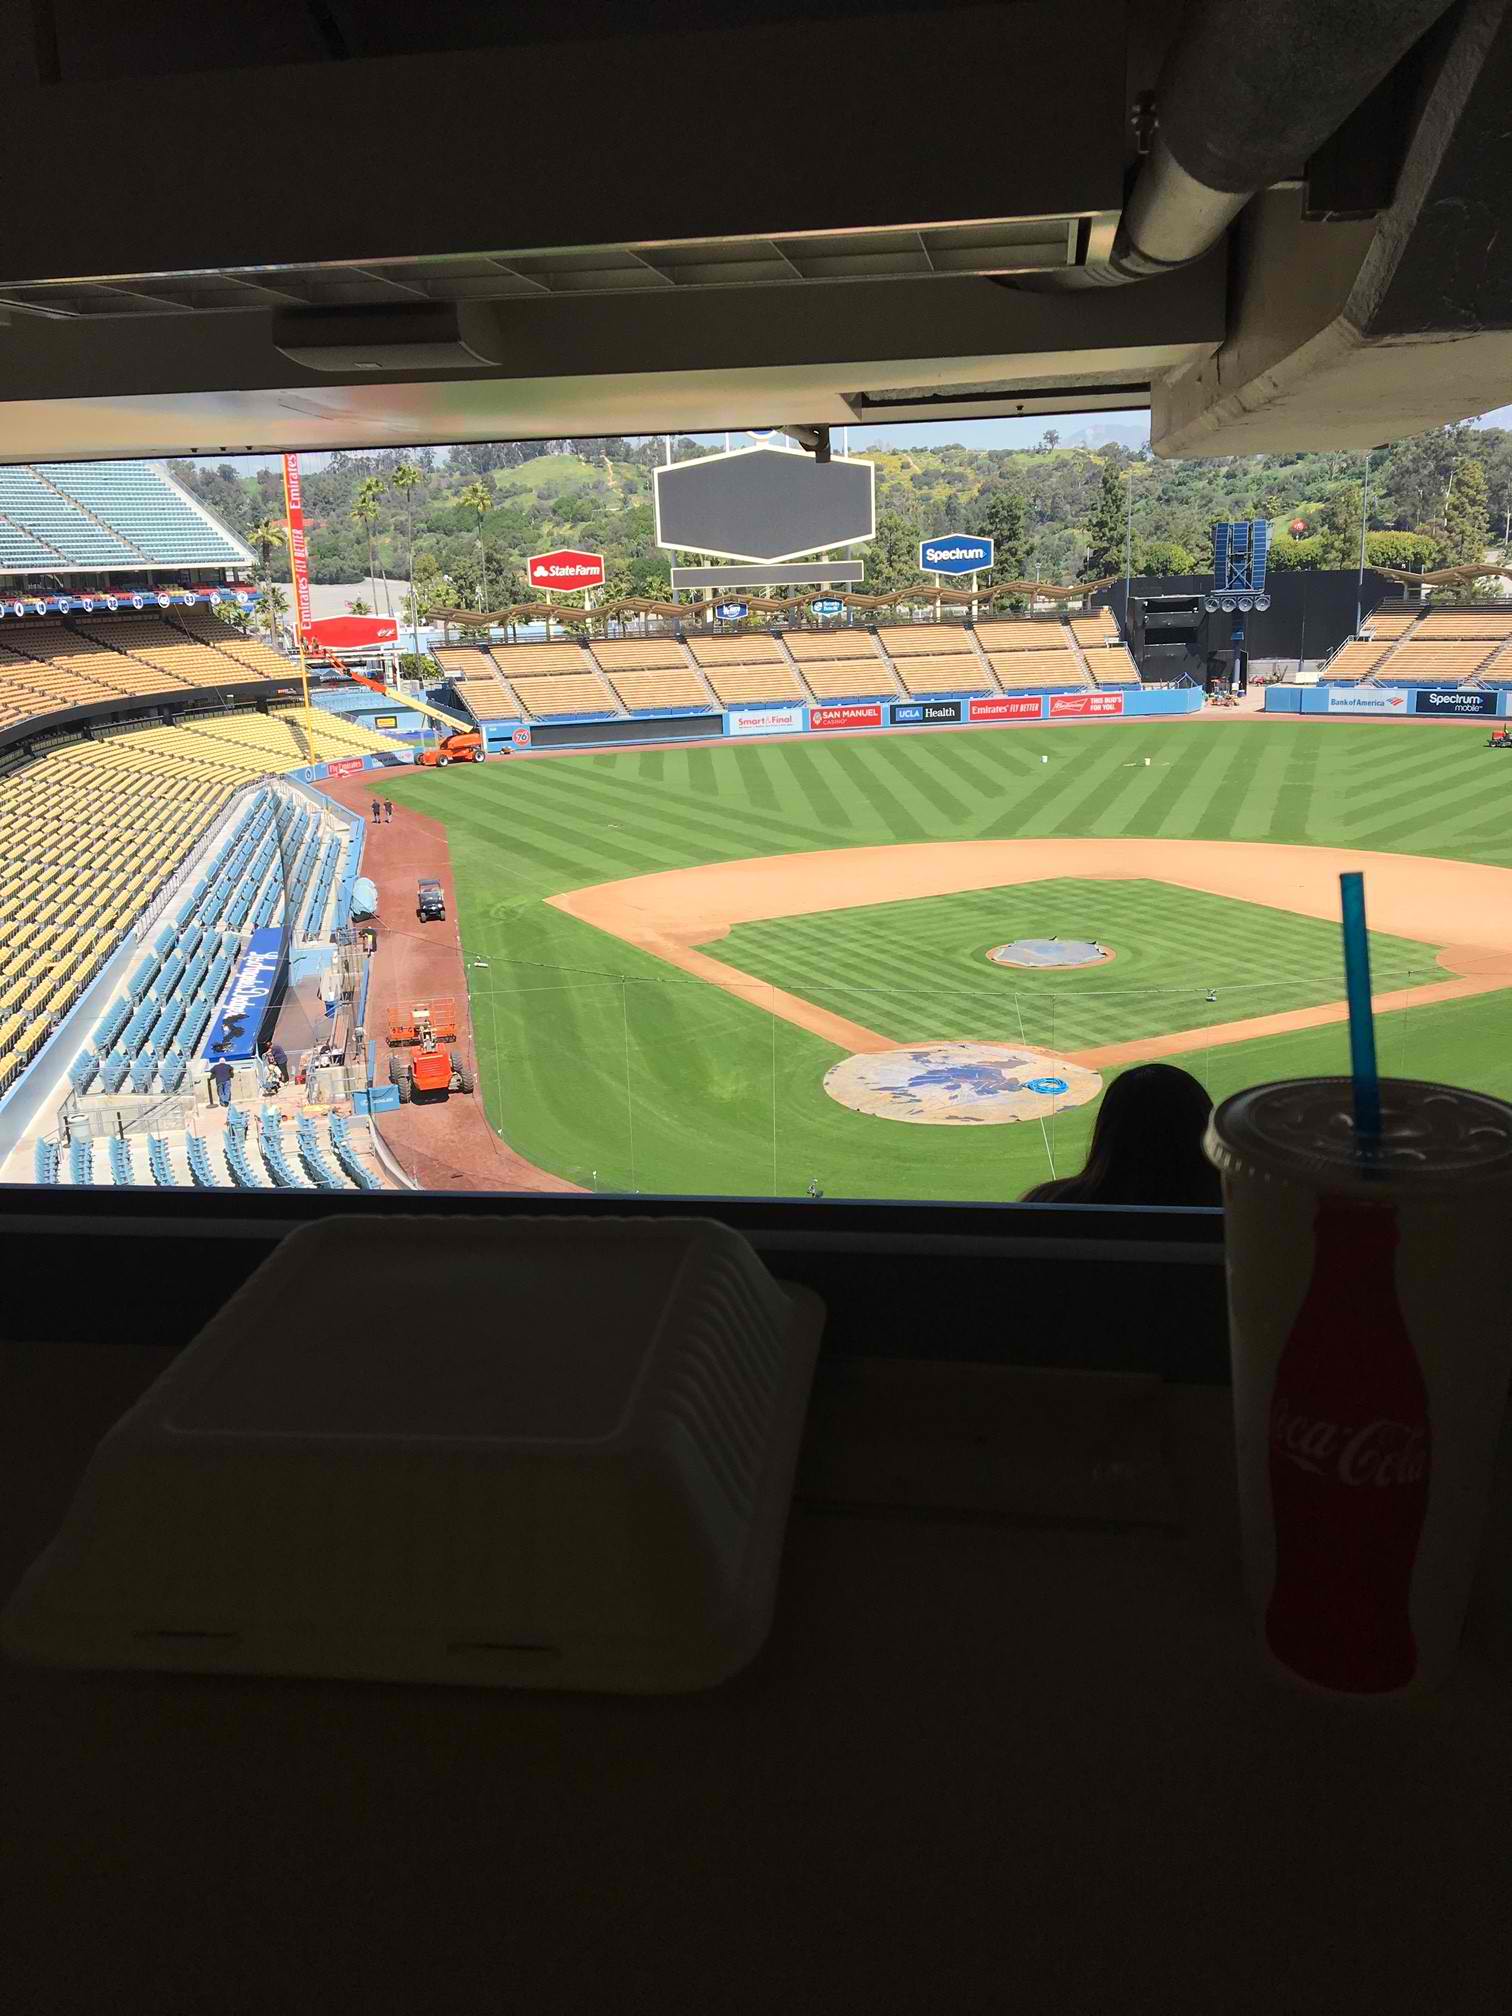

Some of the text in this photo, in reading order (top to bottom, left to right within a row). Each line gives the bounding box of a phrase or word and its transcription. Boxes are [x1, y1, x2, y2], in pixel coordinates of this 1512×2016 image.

[287, 453, 301, 509] Emirates
[926, 547, 984, 564] Spectrum
[298, 576, 312, 630] Emirates
[1330, 698, 1348, 706] Bank
[1356, 699, 1385, 707] America
[1429, 693, 1480, 706] Spectrum
[823, 708, 879, 719] SAN MANUEL
[899, 707, 956, 718] UCLA Health
[1454, 704, 1480, 712] mobile
[738, 718, 765, 726] Smart
[771, 714, 793, 724] Final
